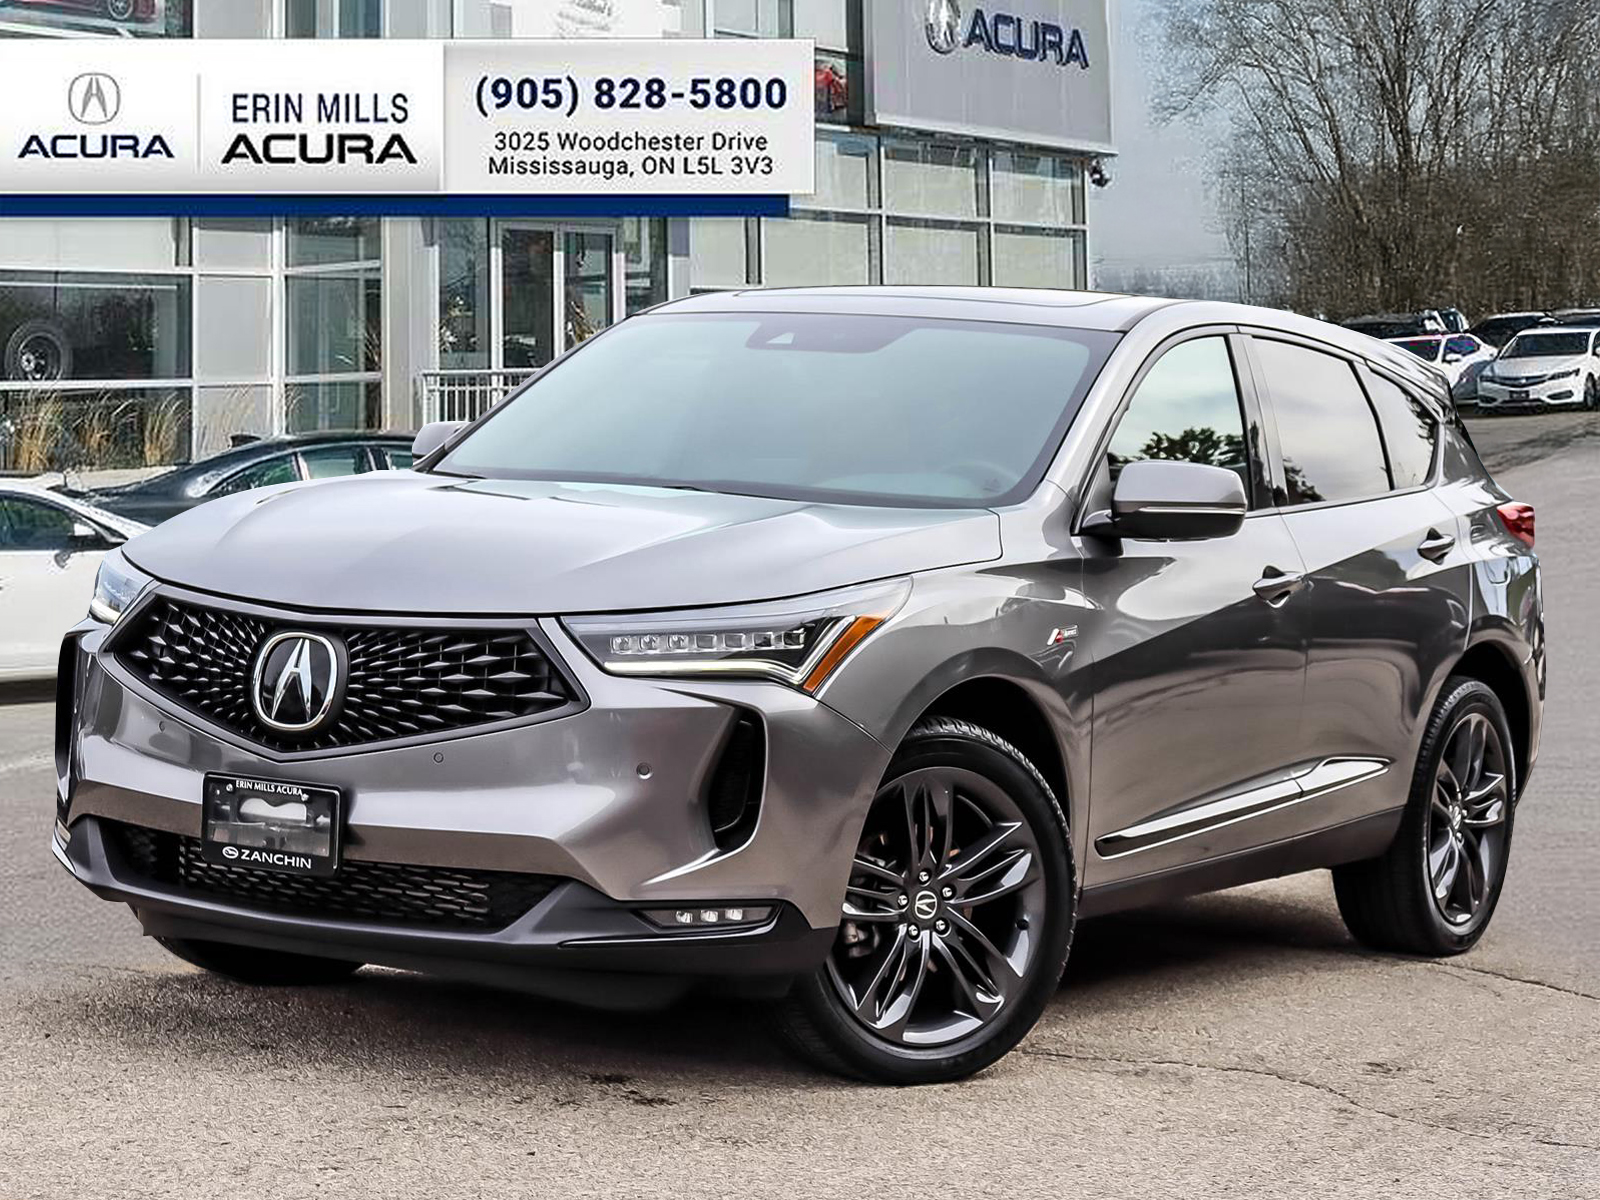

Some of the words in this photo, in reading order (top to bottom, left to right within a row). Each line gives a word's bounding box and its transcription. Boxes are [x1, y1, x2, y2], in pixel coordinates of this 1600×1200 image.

[962, 8, 1090, 70] ACURA
[235, 779, 253, 790] ERIN
[254, 783, 275, 793] MILLS
[276, 786, 303, 796] ACURA
[241, 849, 312, 869] ZANCHIN
